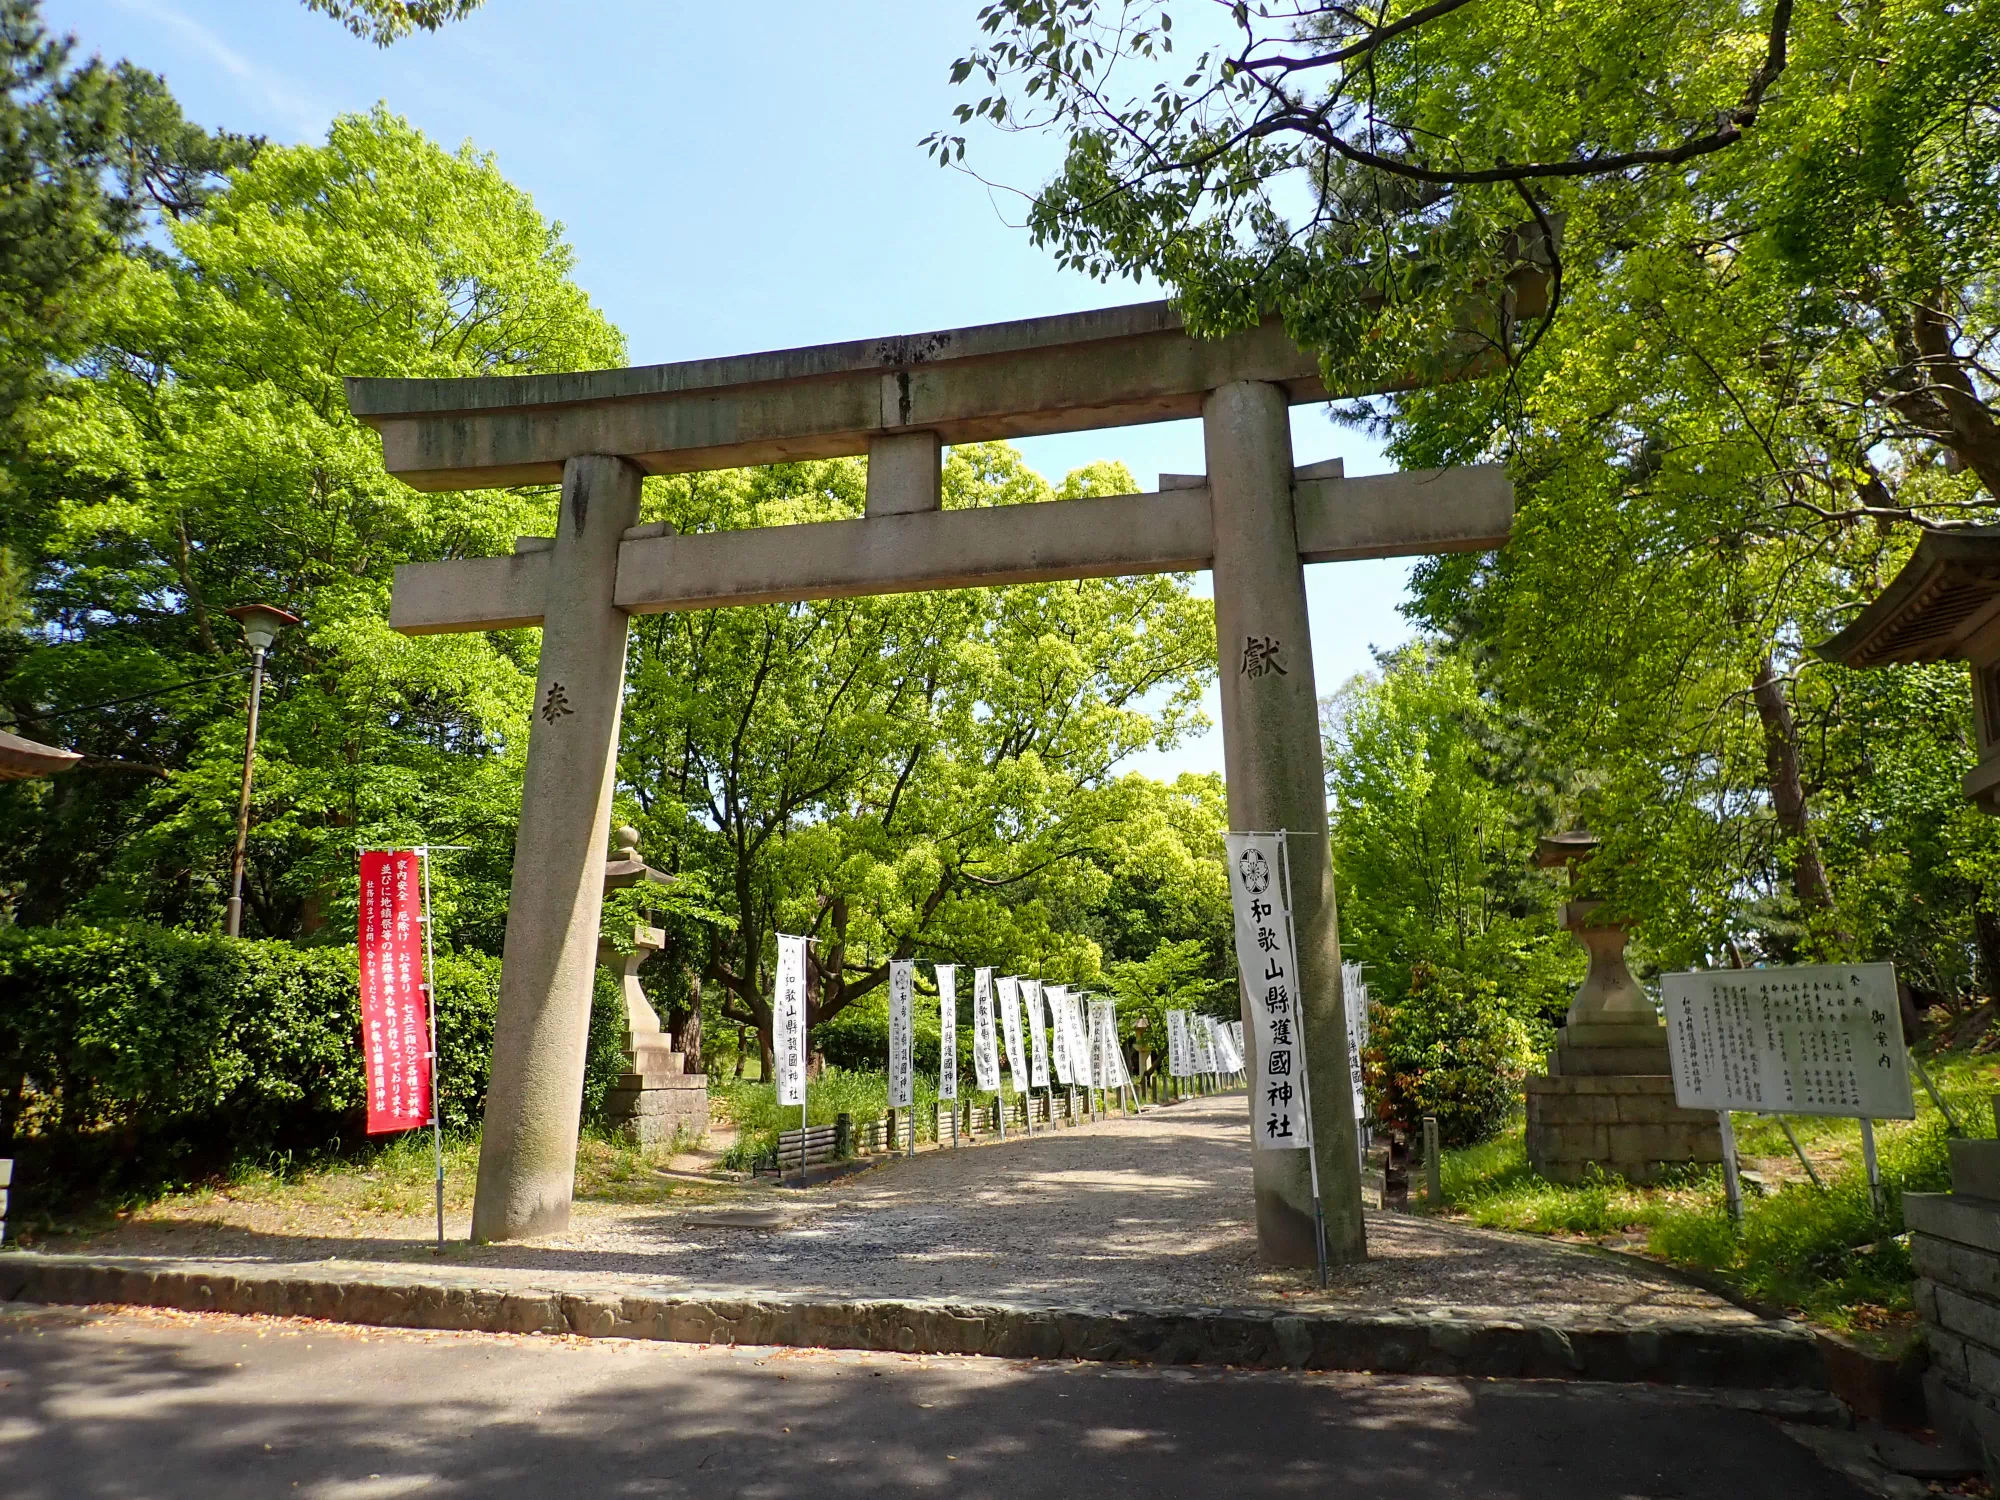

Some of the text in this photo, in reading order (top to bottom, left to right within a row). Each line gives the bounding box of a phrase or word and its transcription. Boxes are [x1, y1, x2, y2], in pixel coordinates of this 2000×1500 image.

[541, 682, 575, 726] 奉
[1250, 897, 1294, 1139] 和歌山縣護國神社
[1870, 1008, 1891, 1069] 御案内
